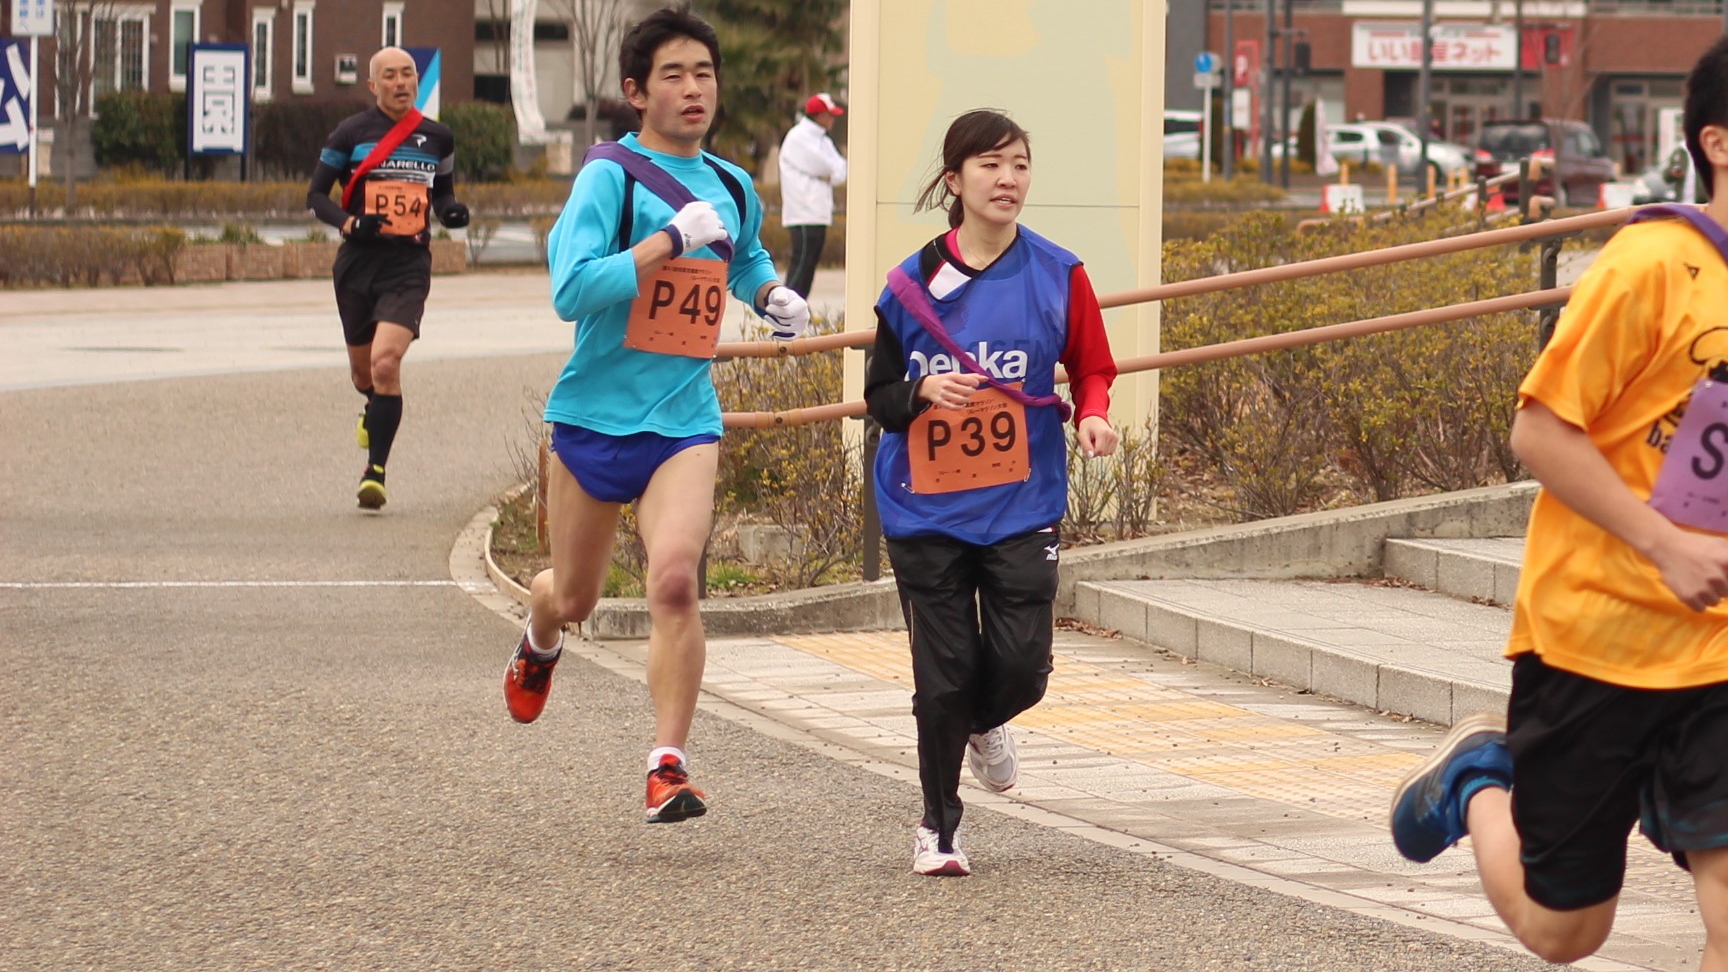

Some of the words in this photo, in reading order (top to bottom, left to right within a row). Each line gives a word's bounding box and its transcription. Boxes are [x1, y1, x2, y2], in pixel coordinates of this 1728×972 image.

[375, 193, 422, 218] P54
[648, 279, 722, 327] P49
[927, 411, 1016, 461] P39
